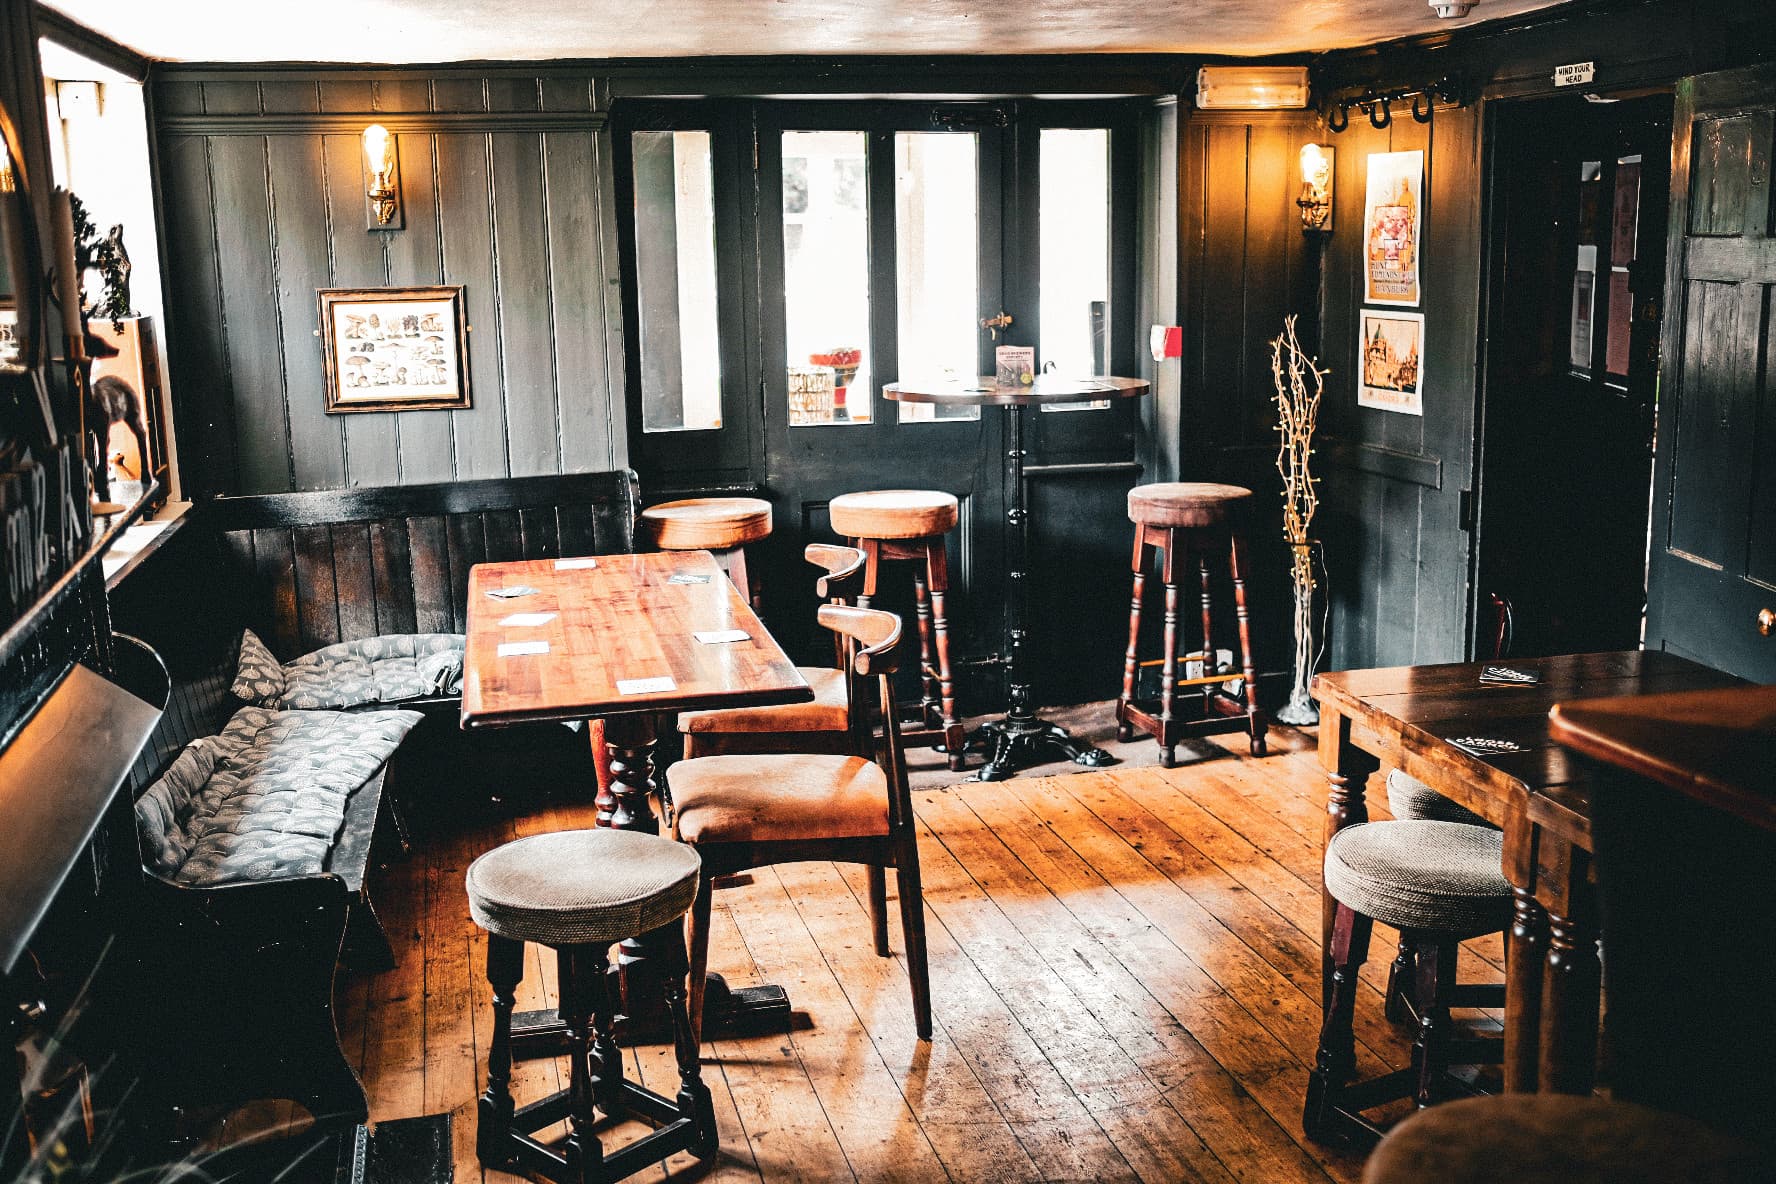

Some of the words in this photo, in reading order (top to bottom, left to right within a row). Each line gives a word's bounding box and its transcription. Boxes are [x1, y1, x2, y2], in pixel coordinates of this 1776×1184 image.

[1558, 66, 1573, 75] MIND
[1574, 63, 1590, 73] YOUR
[1565, 74, 1582, 83] HEAD
